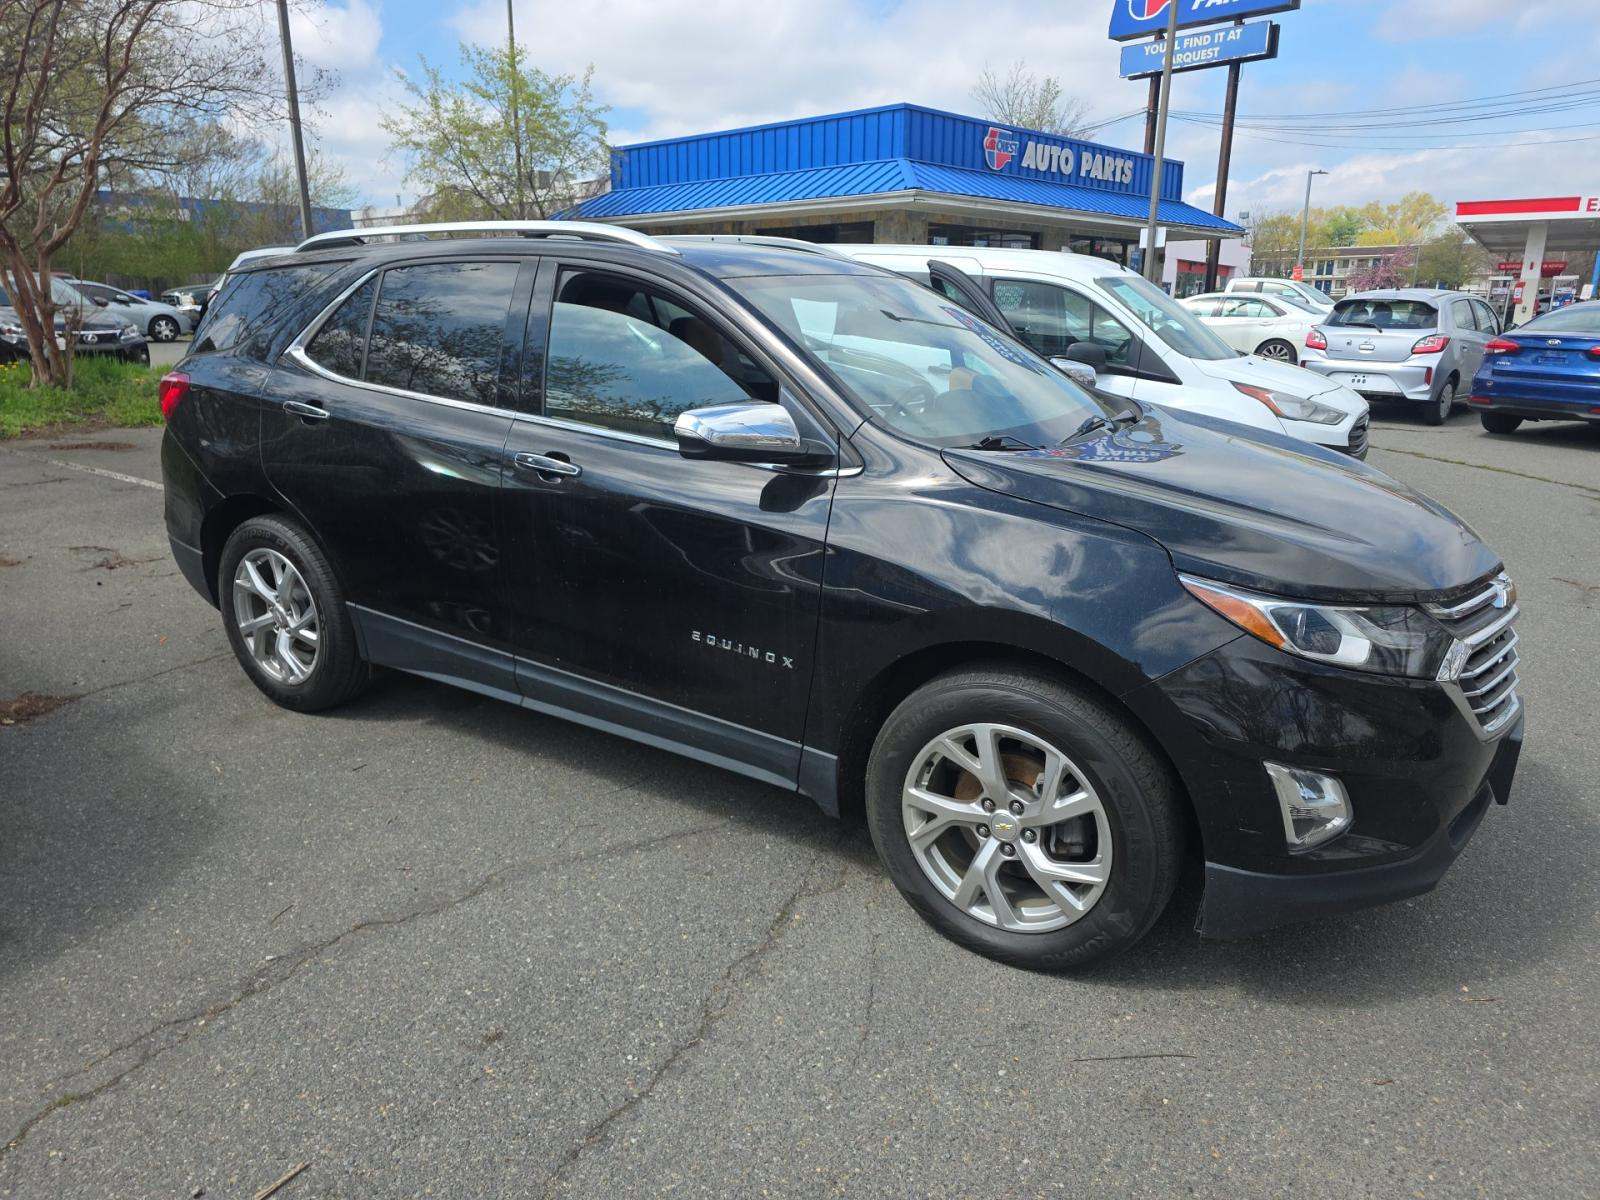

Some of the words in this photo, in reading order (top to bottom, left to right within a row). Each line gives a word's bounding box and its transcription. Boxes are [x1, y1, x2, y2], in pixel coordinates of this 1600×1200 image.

[1144, 40, 1180, 55] YOUL
[1184, 34, 1212, 48] FIND
[1215, 31, 1226, 44] IT
[1227, 28, 1243, 41] AT
[1021, 141, 1075, 175] AUTO
[1079, 151, 1134, 184] PARTS
[1586, 197, 1600, 212] E
[691, 630, 794, 669] EQUINOX
